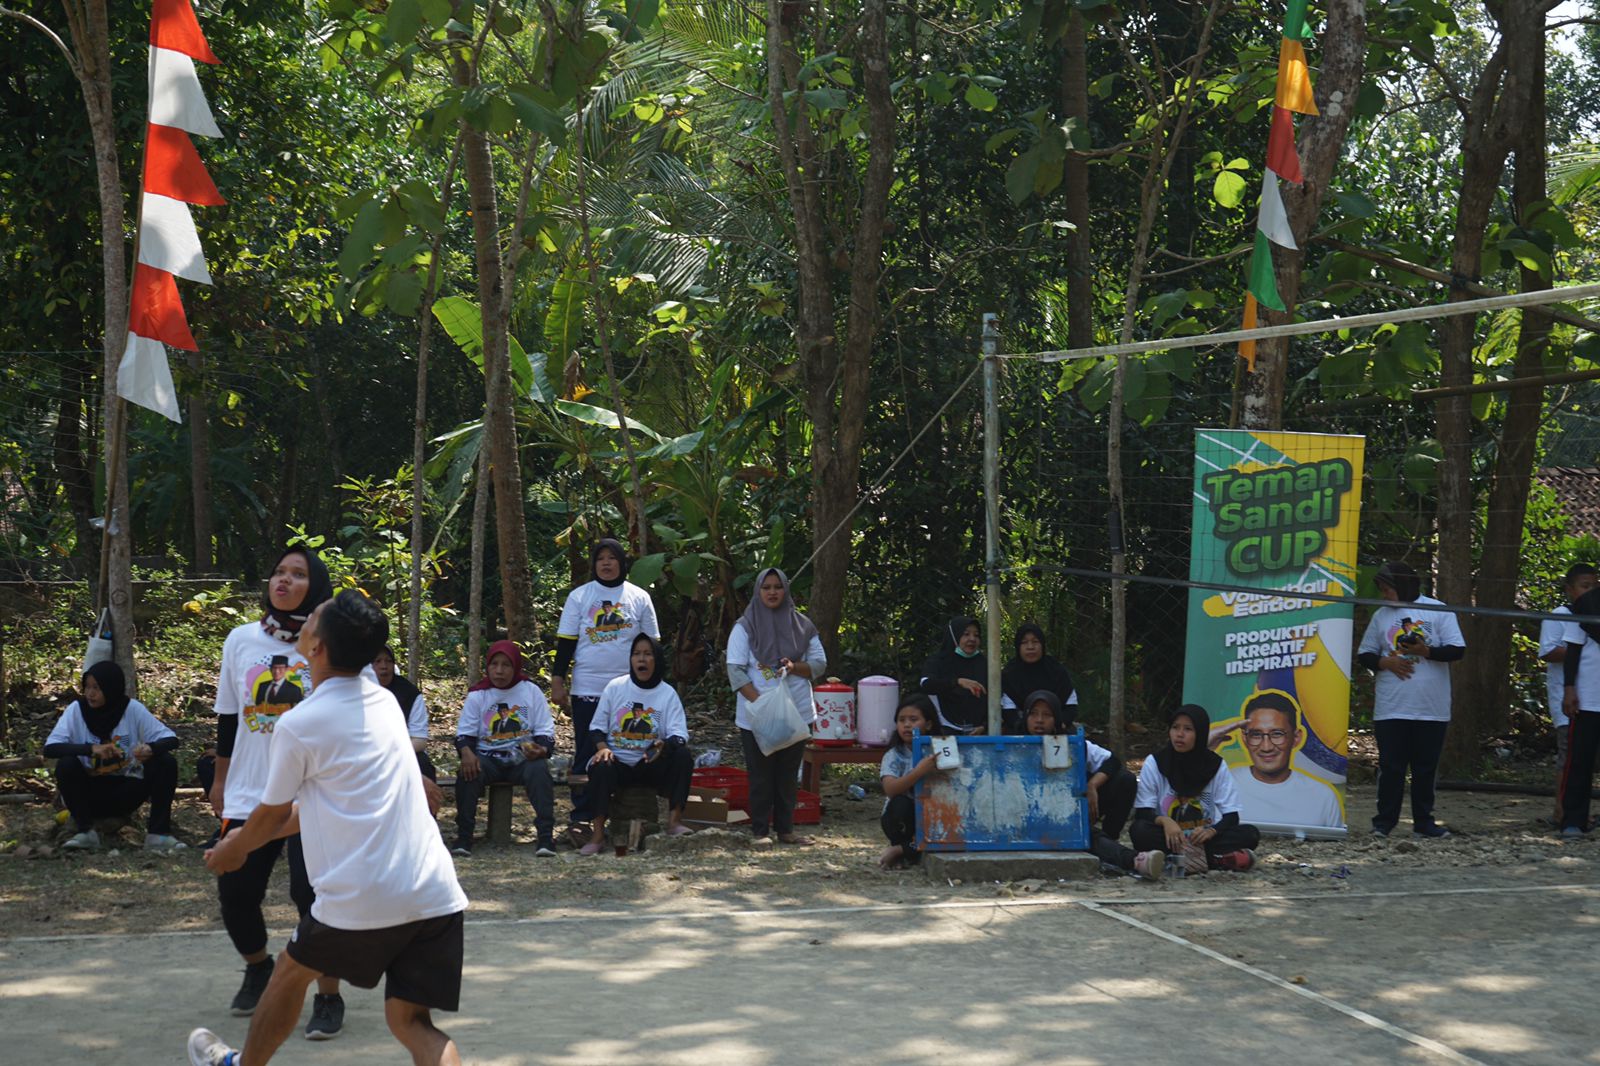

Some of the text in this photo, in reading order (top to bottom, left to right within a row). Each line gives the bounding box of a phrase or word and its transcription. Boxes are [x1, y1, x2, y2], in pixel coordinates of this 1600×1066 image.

[1206, 462, 1345, 505] Teman
[1218, 487, 1334, 533] Sandi
[1230, 529, 1322, 574] CUP
[1232, 598, 1312, 618] Edition
[1225, 623, 1319, 647] PRODUKTIF
[943, 746, 951, 757] 5
[1053, 745, 1061, 756] 7
